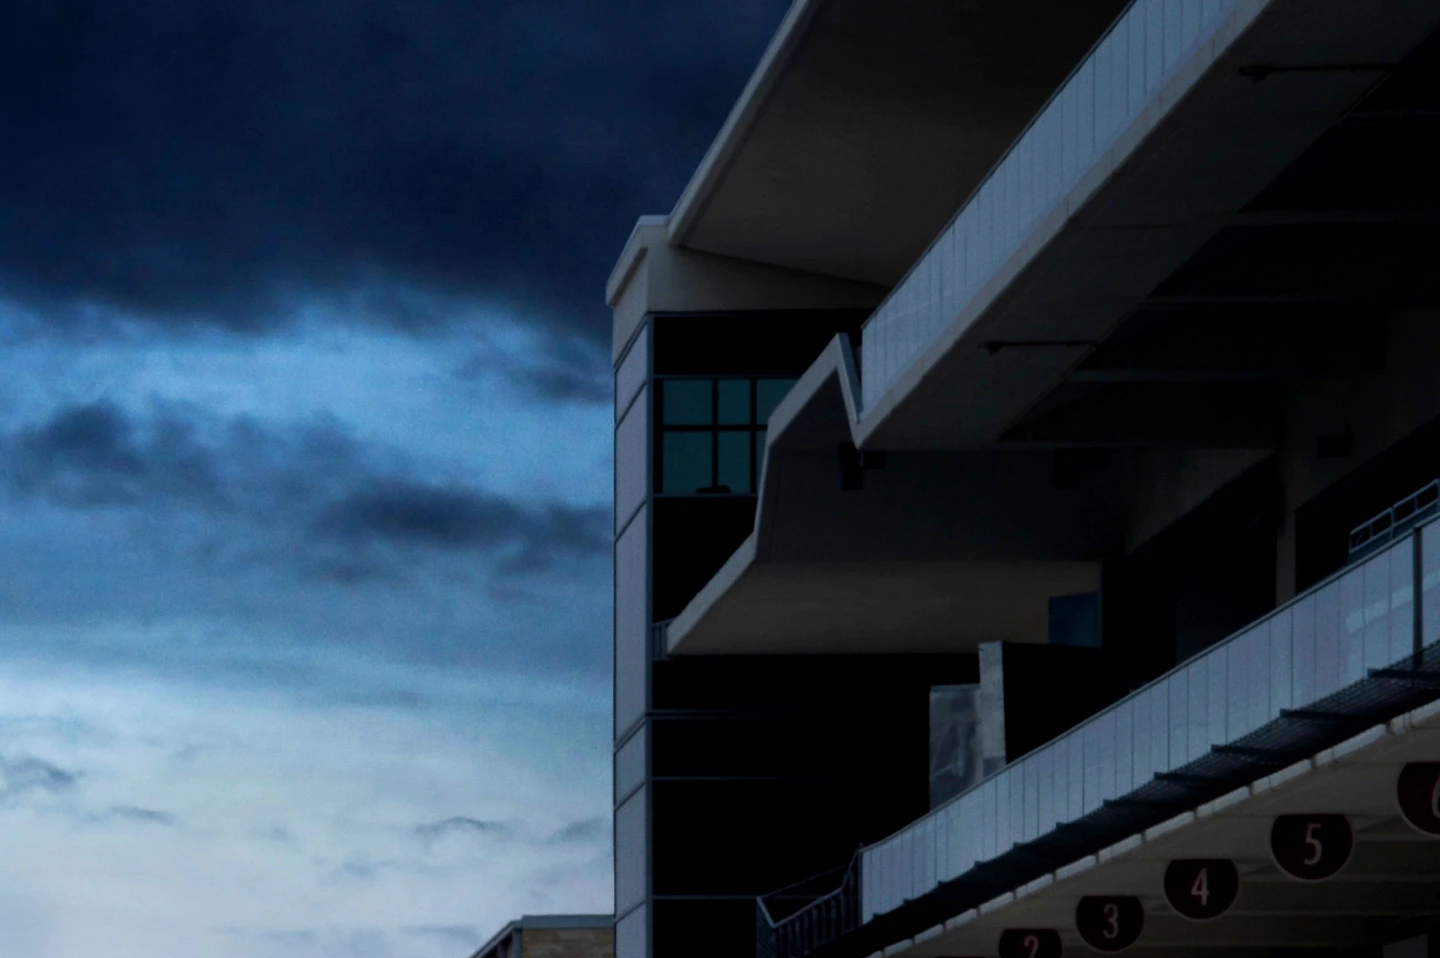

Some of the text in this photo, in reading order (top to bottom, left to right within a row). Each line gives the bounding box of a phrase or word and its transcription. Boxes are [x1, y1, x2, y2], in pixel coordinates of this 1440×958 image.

[1303, 822, 1322, 865] 5
[1191, 867, 1210, 906] 4
[1103, 903, 1120, 939] 3
